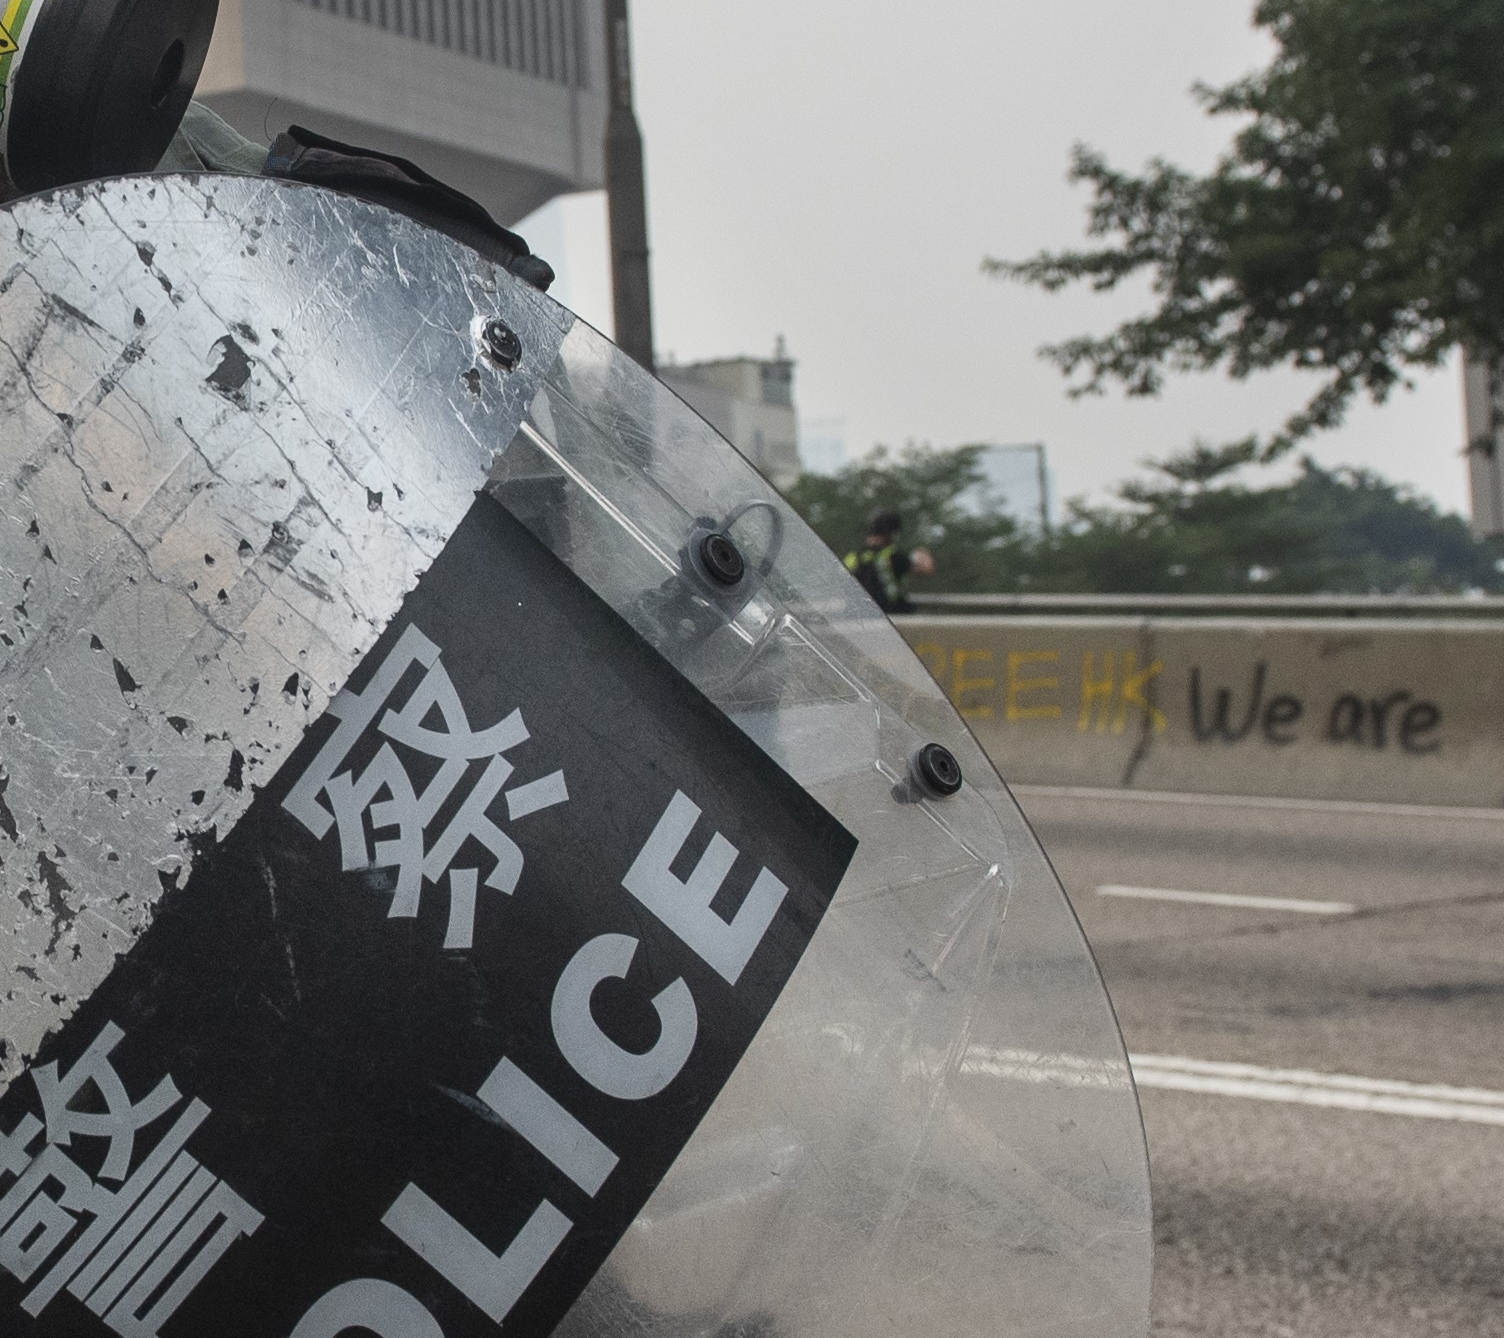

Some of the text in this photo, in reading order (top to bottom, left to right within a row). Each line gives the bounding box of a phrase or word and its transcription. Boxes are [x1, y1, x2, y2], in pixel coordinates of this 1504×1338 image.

[1077, 650, 1167, 733] HK
[1190, 662, 1304, 746] We
[1326, 687, 1443, 755] are
